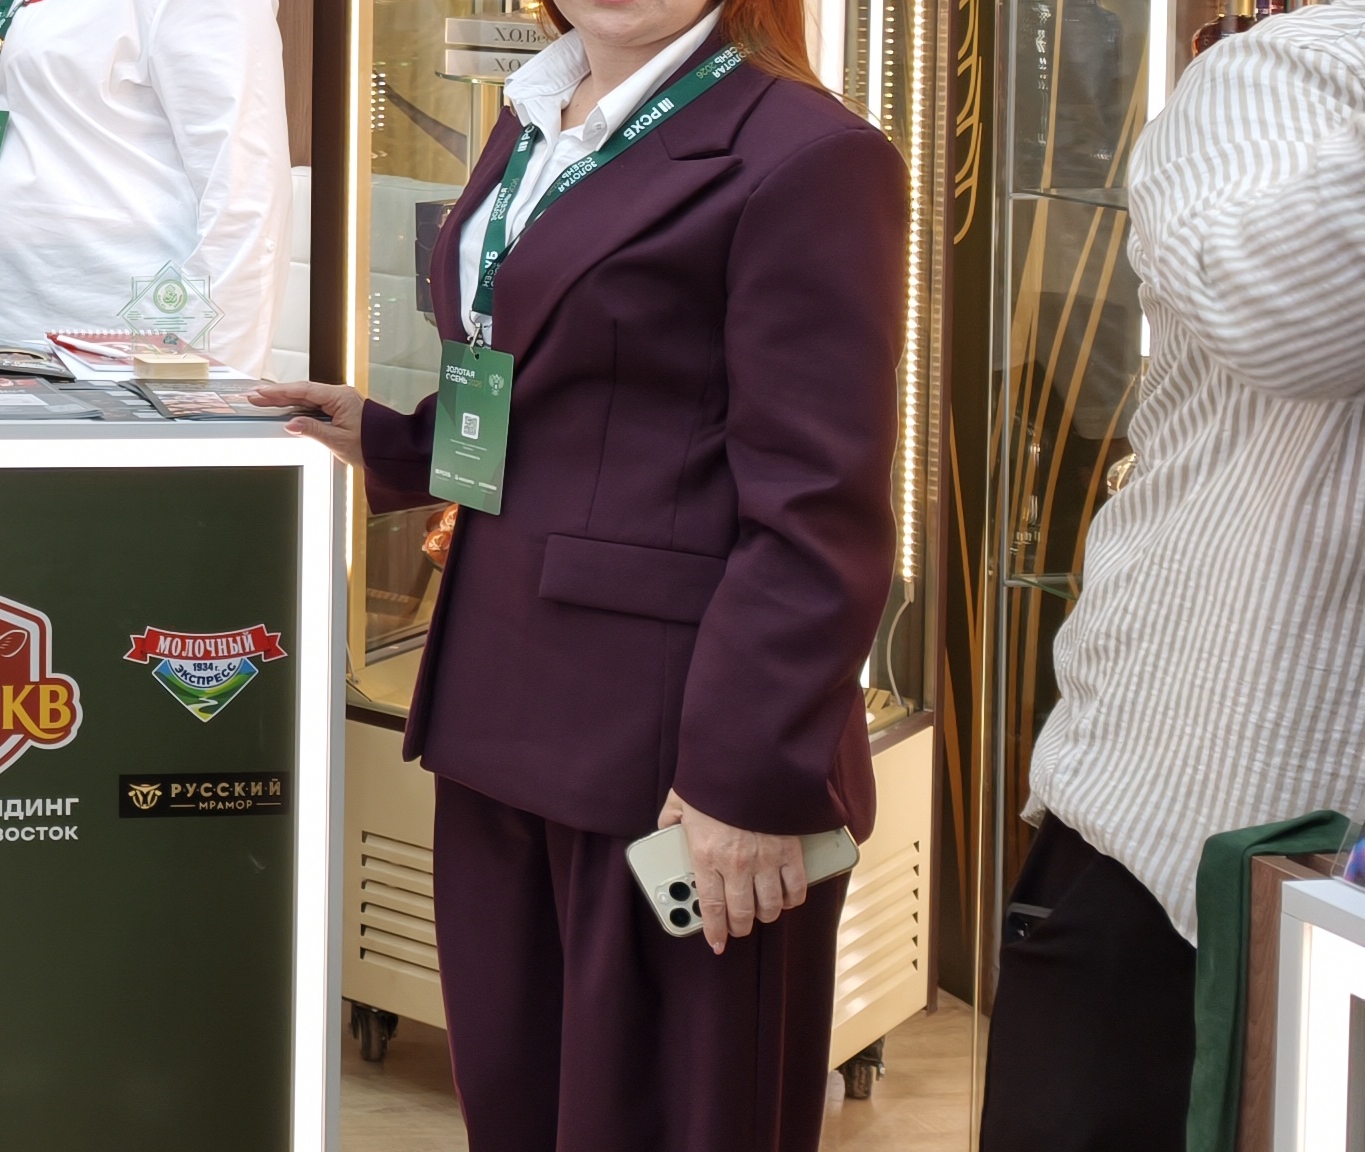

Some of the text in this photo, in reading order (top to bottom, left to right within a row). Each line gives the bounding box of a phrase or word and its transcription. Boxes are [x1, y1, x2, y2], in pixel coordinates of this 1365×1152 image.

[623, 107, 662, 140] РСХБ
[557, 160, 598, 193] ЗОЛОТАЯ
[155, 631, 256, 657] МОЛОЧНЫЙ
[175, 662, 237, 686] ЭКСПРЕСС
[193, 662, 214, 672] 1934
[199, 800, 253, 811] МРАМОР
